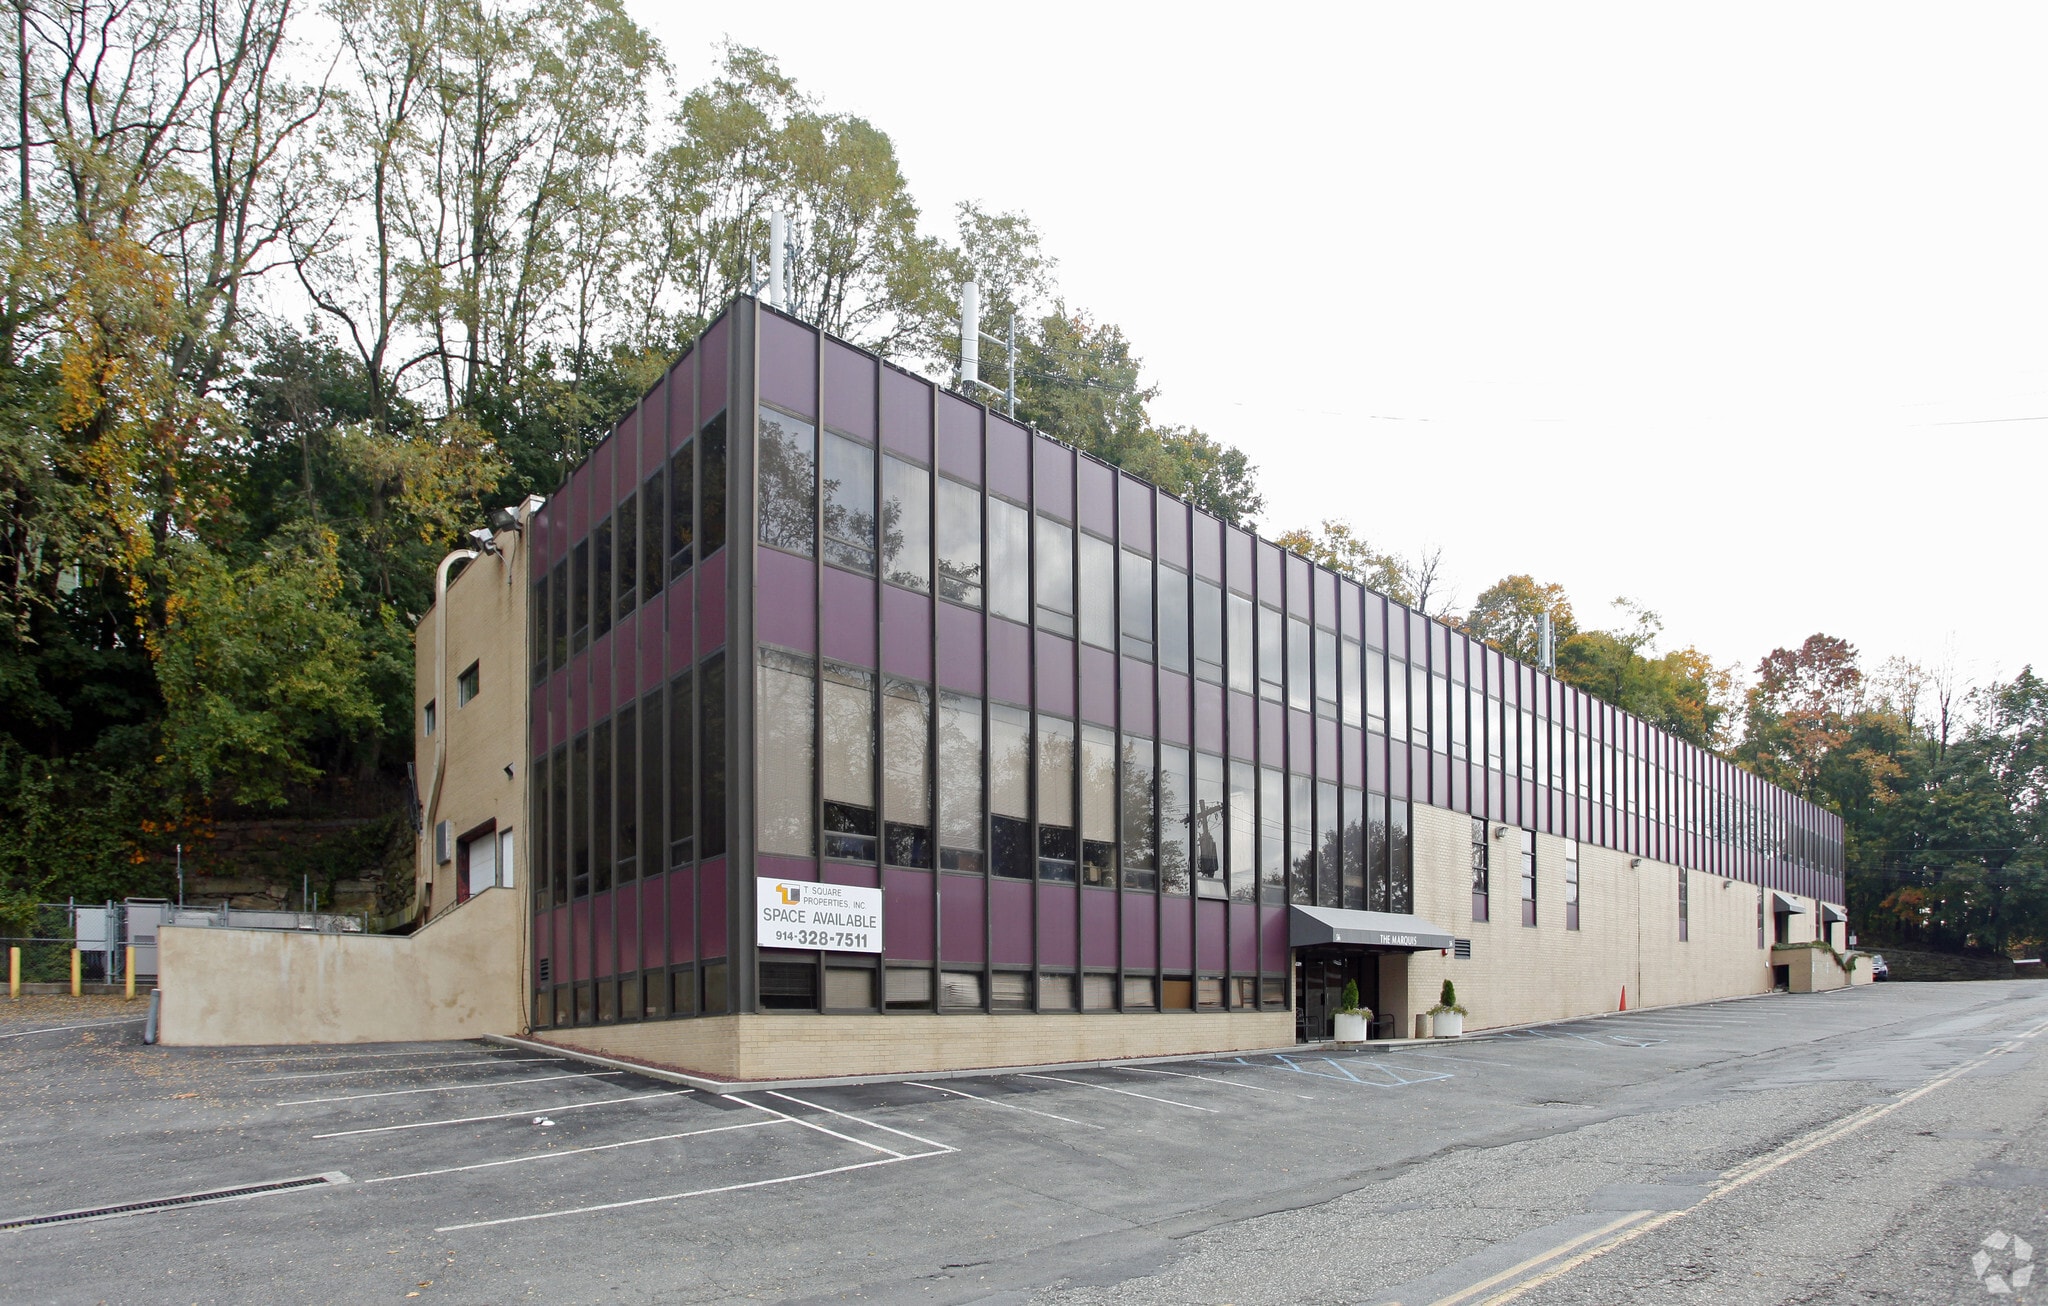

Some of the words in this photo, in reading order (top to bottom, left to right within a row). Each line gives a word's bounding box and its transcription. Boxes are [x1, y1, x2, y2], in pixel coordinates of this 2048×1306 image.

[812, 886, 842, 897] SQUARE
[803, 897, 850, 909] PROPERTIES,
[763, 907, 806, 923] SPACE
[813, 911, 877, 928] AVAILABLE
[776, 930, 868, 948] 914-328-7511
[1380, 934, 1391, 944] THE
[1392, 935, 1417, 946] MARQUIS
